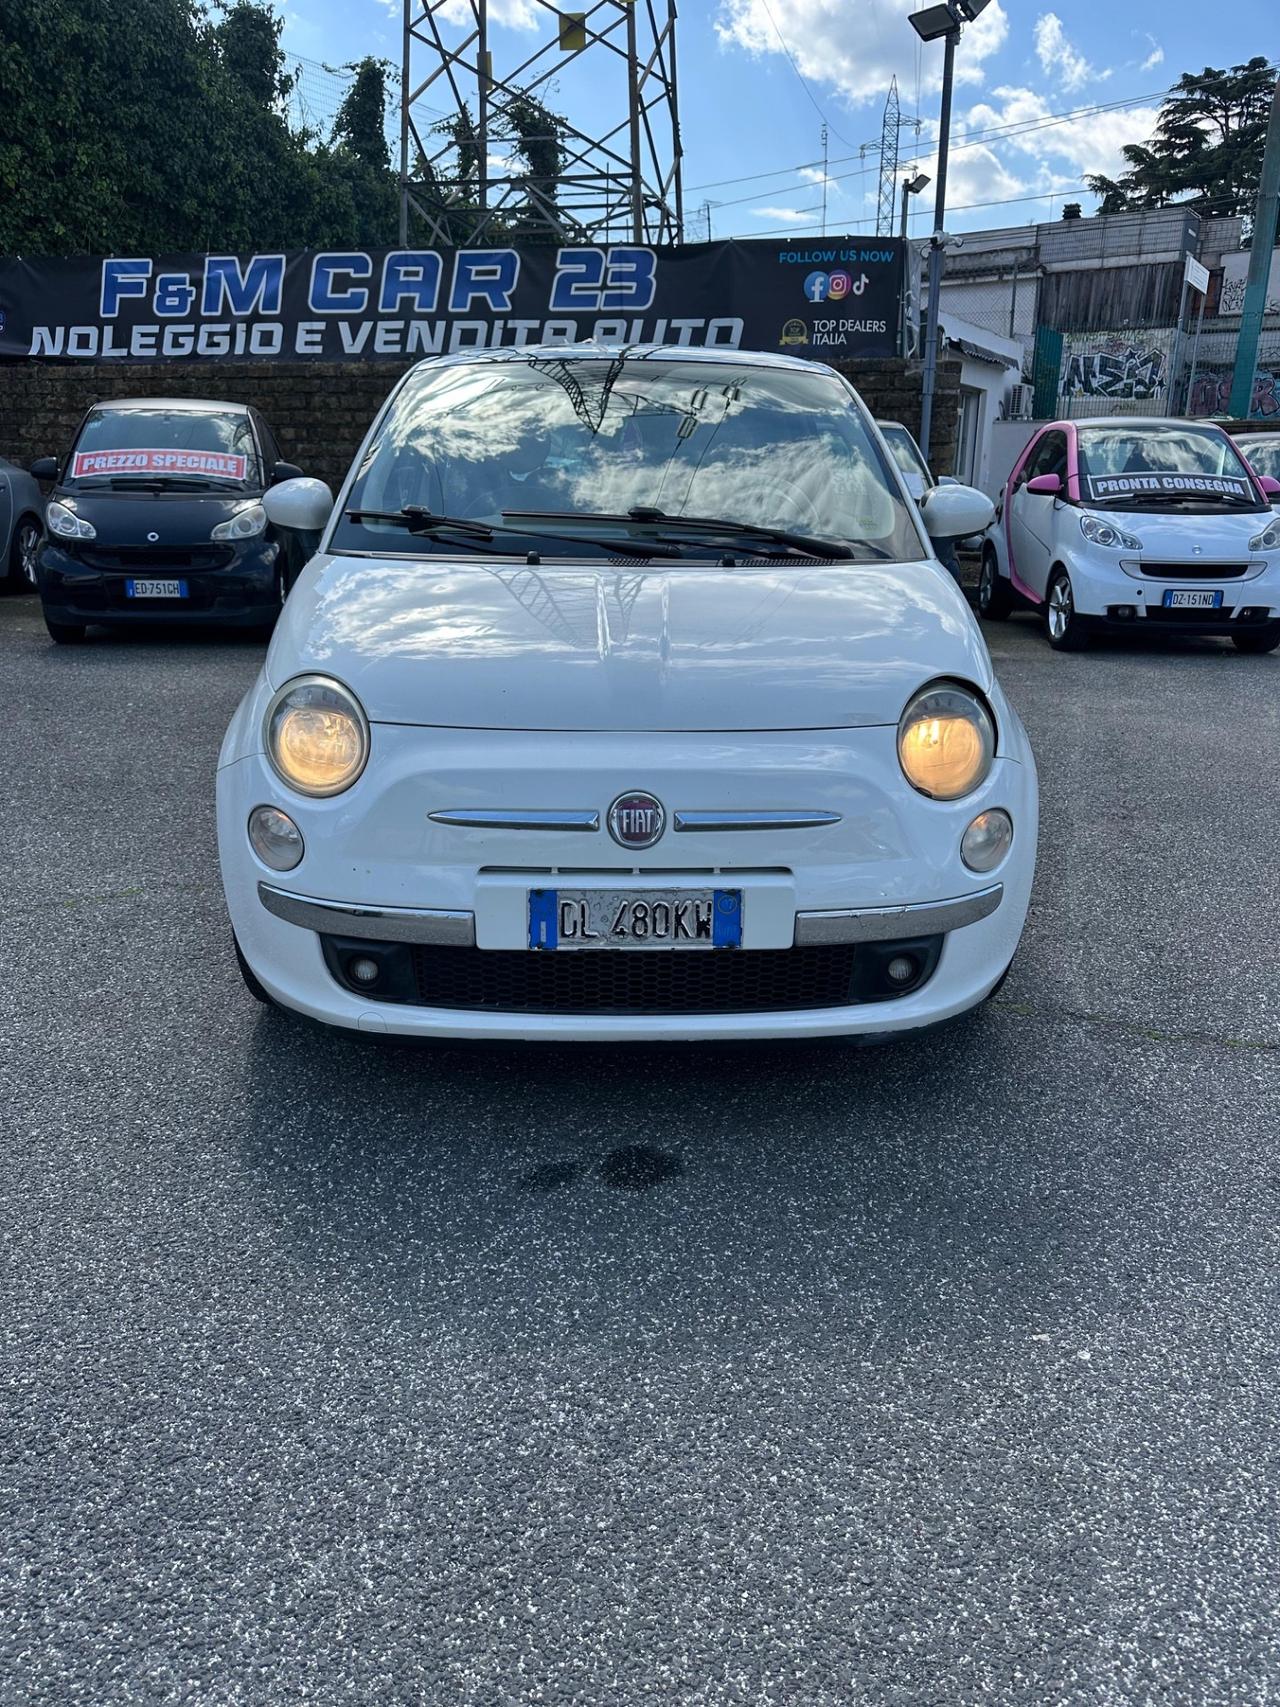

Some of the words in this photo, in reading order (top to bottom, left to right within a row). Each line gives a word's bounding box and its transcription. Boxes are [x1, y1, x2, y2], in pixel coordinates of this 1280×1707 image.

[779, 250, 836, 264] FOLLOW
[840, 249, 857, 261] US
[860, 250, 894, 262] NOW
[100, 254, 287, 317] F&M
[308, 248, 520, 315] CAR
[549, 246, 658, 312] 23
[295, 321, 326, 354] E
[592, 316, 745, 351] AUTO
[813, 320, 836, 333] TOP
[839, 320, 886, 333] DEALERS
[812, 334, 847, 345] ITALIA
[82, 454, 148, 471] PREZZO
[152, 454, 237, 473] SPECIALE
[1096, 477, 1161, 493] PRONTA
[1161, 477, 1244, 496] CONSEGNA
[622, 809, 654, 833] FIAT
[560, 900, 599, 939] DL
